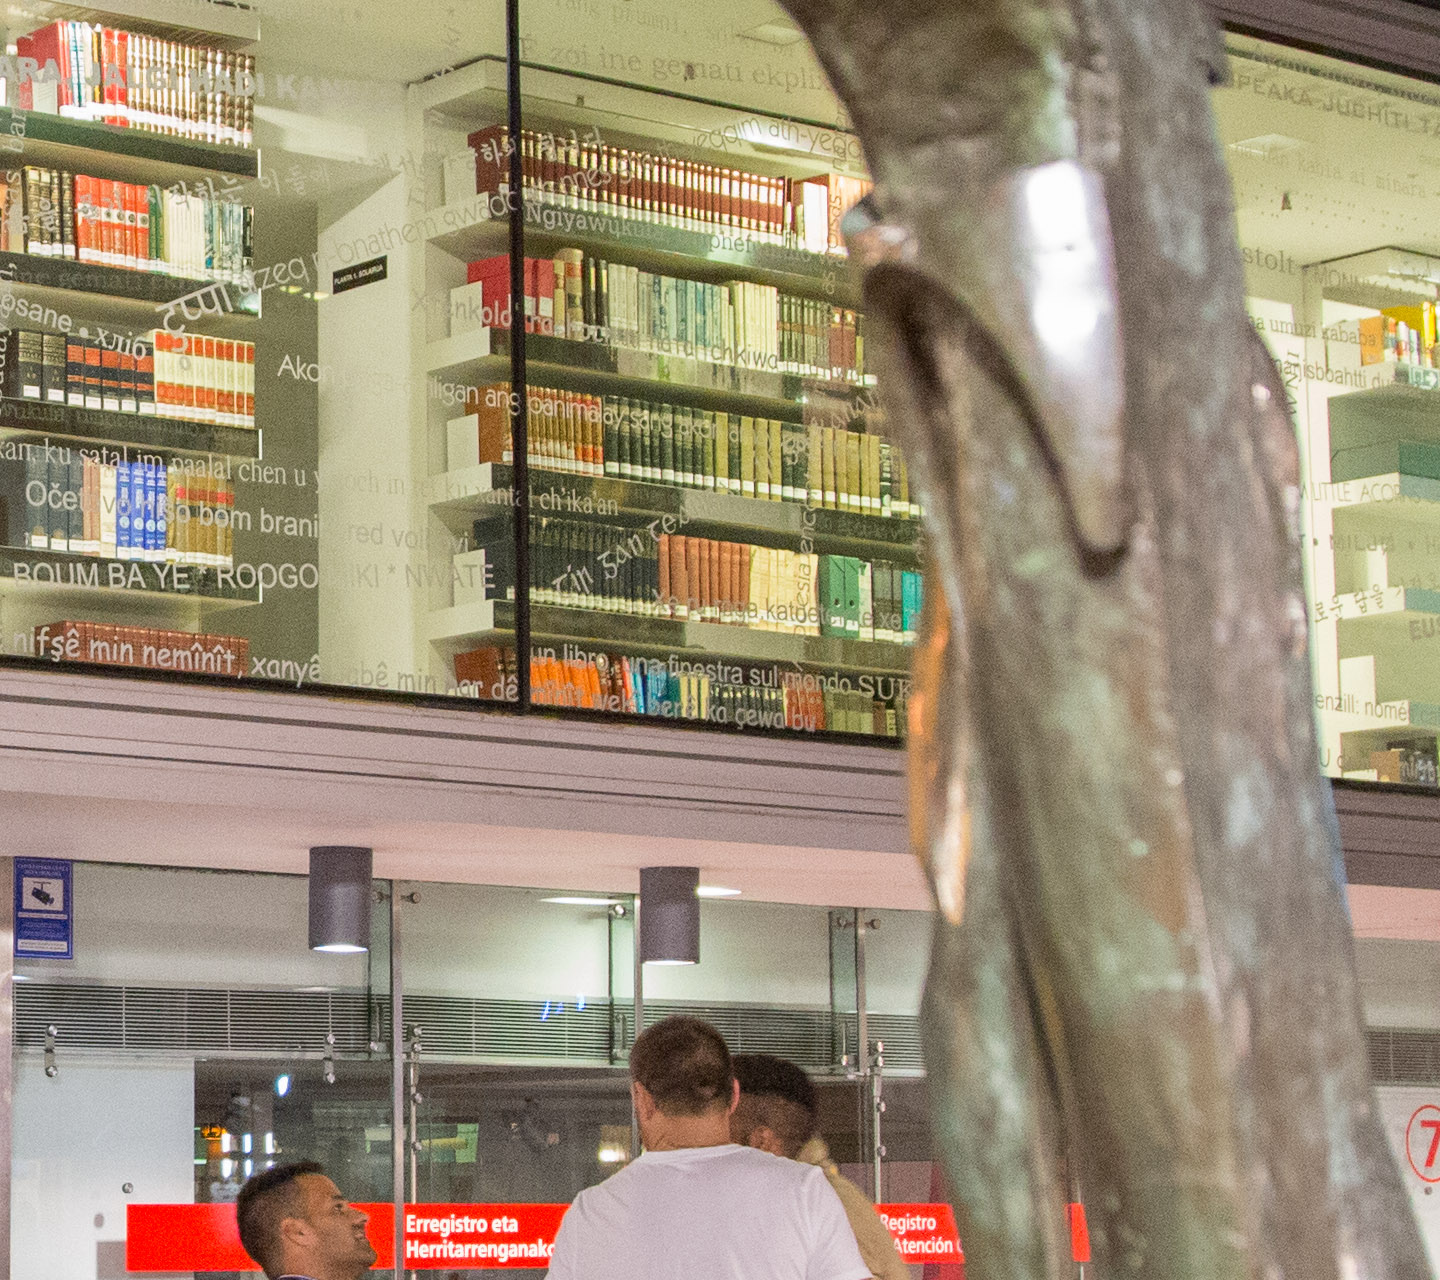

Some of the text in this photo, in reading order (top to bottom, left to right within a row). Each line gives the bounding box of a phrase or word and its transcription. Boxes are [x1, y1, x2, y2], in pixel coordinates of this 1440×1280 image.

[600, 46, 641, 72] ine
[1243, 245, 1294, 272] stolt
[13, 562, 99, 590] BOUM
[107, 564, 146, 588] BA
[153, 563, 191, 589] YE
[90, 637, 133, 665] min
[748, 660, 780, 687] sul
[1315, 694, 1360, 716] enzill:
[406, 1214, 519, 1237] Erregistro eta
[880, 1213, 937, 1235] Registro
[893, 1234, 954, 1256] Atención
